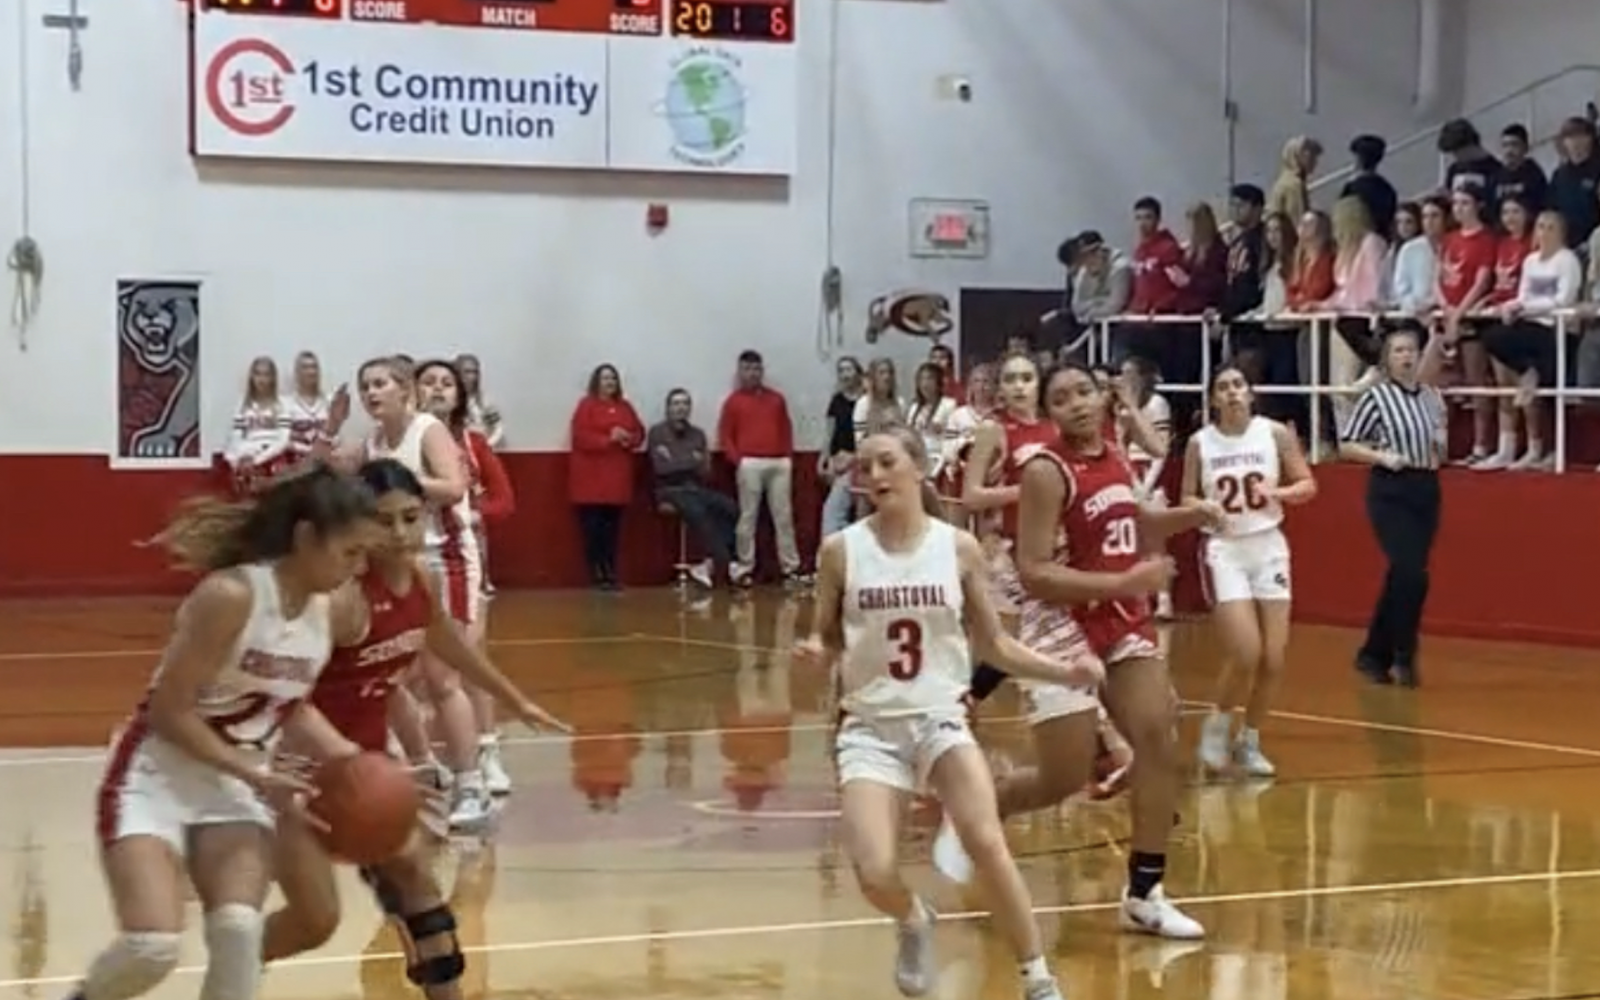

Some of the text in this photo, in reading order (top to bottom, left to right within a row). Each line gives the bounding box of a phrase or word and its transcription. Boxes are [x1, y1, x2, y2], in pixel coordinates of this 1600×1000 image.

[354, 1, 407, 20] SCORE
[481, 6, 537, 27] MATCH
[609, 12, 660, 33] SCORE
[676, 2, 712, 31] 20
[770, 7, 787, 36] 6
[229, 69, 284, 108] 1st
[302, 60, 599, 117] 1st Community
[350, 103, 555, 139] Credit Union
[1101, 517, 1137, 556] 20
[858, 584, 949, 610] CHRISTOVAL
[887, 618, 923, 683] 3
